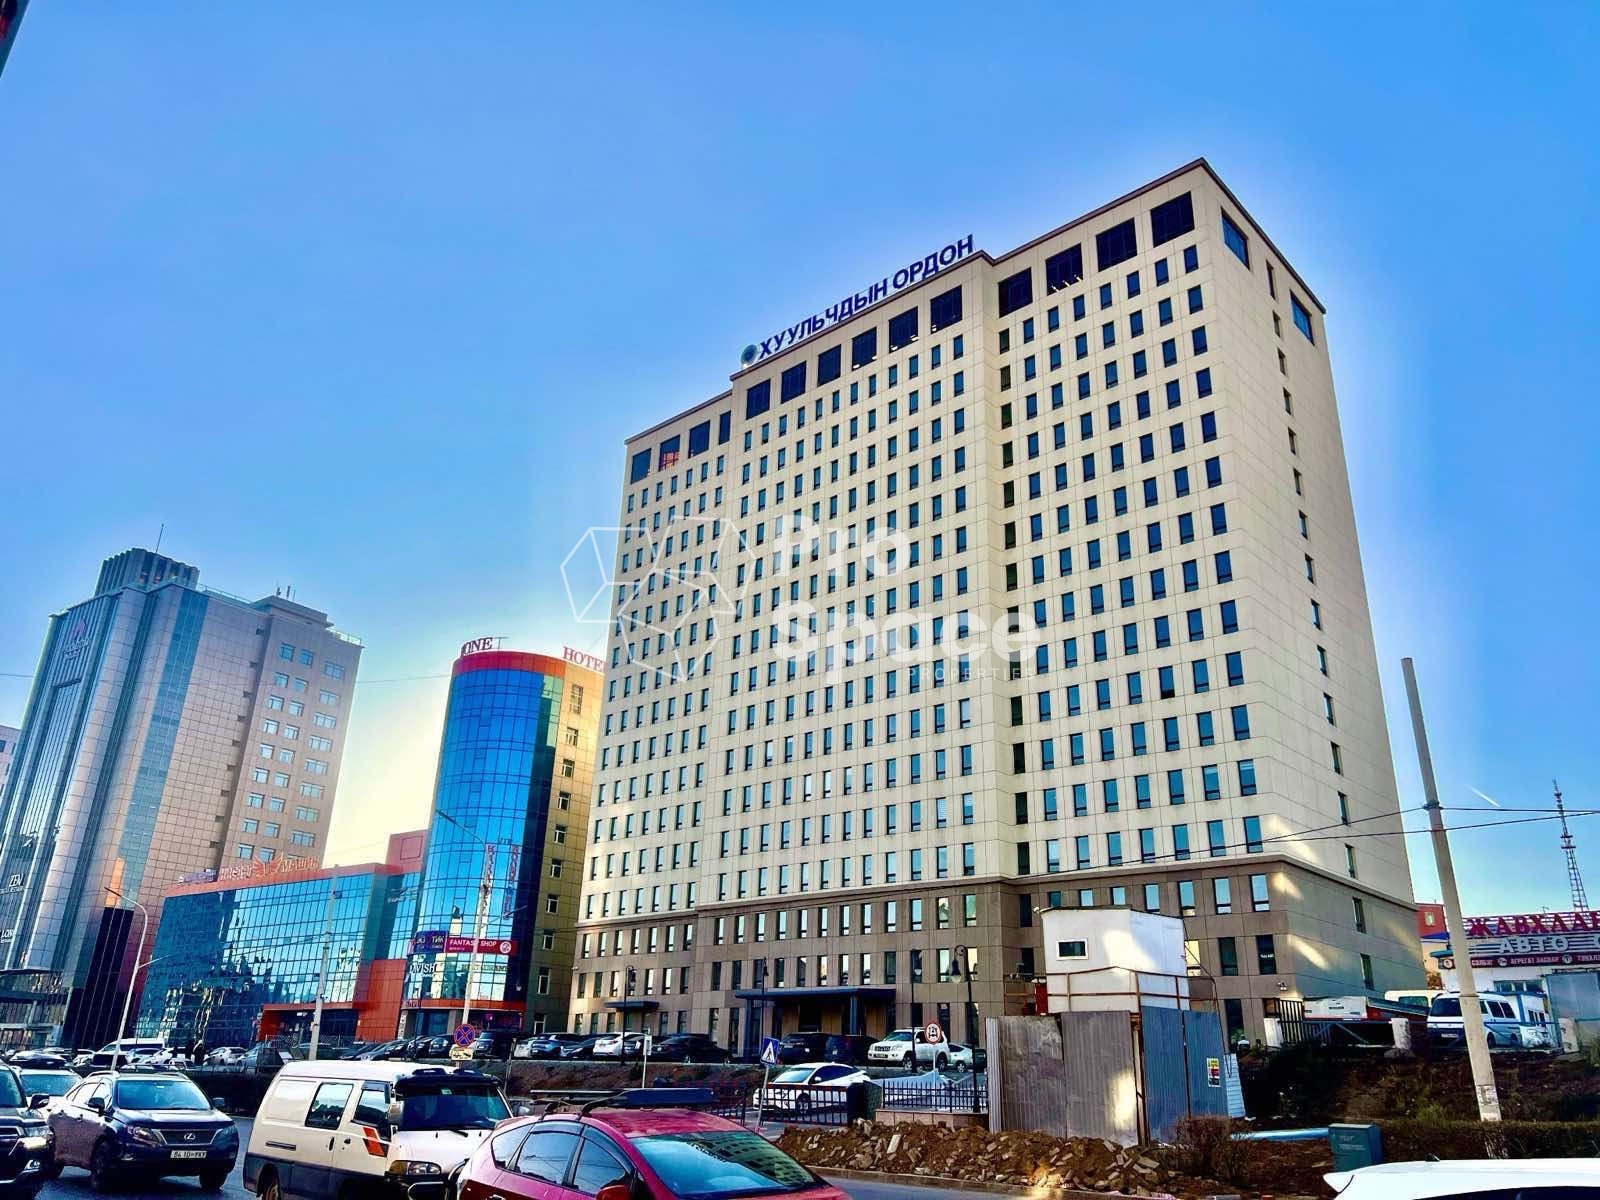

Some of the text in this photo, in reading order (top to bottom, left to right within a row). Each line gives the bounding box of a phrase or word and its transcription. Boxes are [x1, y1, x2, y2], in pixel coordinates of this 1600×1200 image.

[758, 234, 974, 360] ХУУЛЬЧДЫН ОРДОН
[460, 637, 493, 655] ONE
[1499, 935, 1569, 954] АВТО
